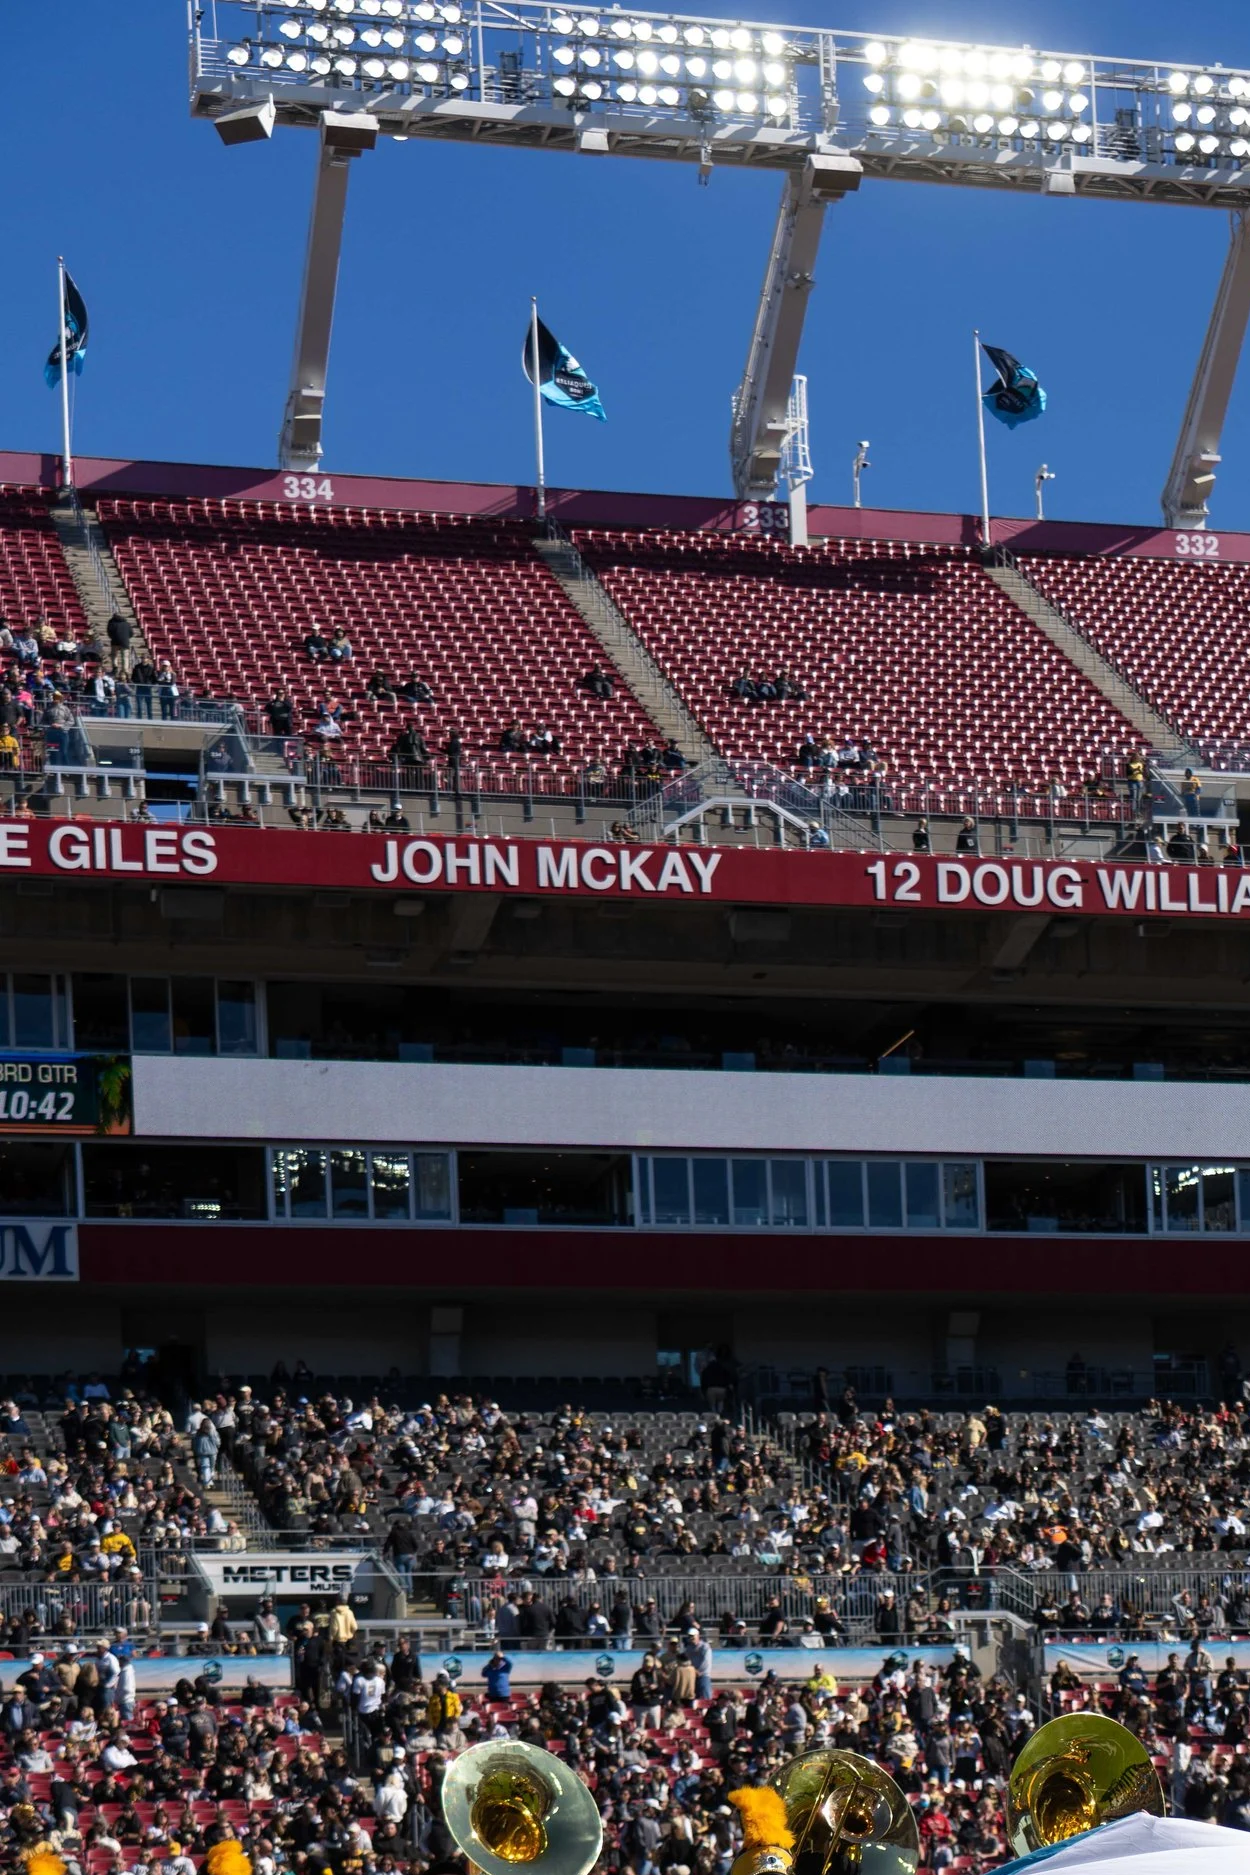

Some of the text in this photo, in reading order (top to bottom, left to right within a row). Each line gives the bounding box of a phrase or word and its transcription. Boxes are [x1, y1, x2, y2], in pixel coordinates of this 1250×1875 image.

[283, 475, 334, 501] 334
[743, 505, 789, 528] 333
[1175, 533, 1220, 557] 332
[0, 824, 218, 875] E GILES
[371, 840, 722, 894] JOHN MCKAY
[867, 860, 921, 902] 12
[937, 862, 1083, 908] DOUG
[37, 1064, 77, 1083] QTR
[0, 1090, 75, 1120] 10:42
[223, 1565, 353, 1583] METERS
